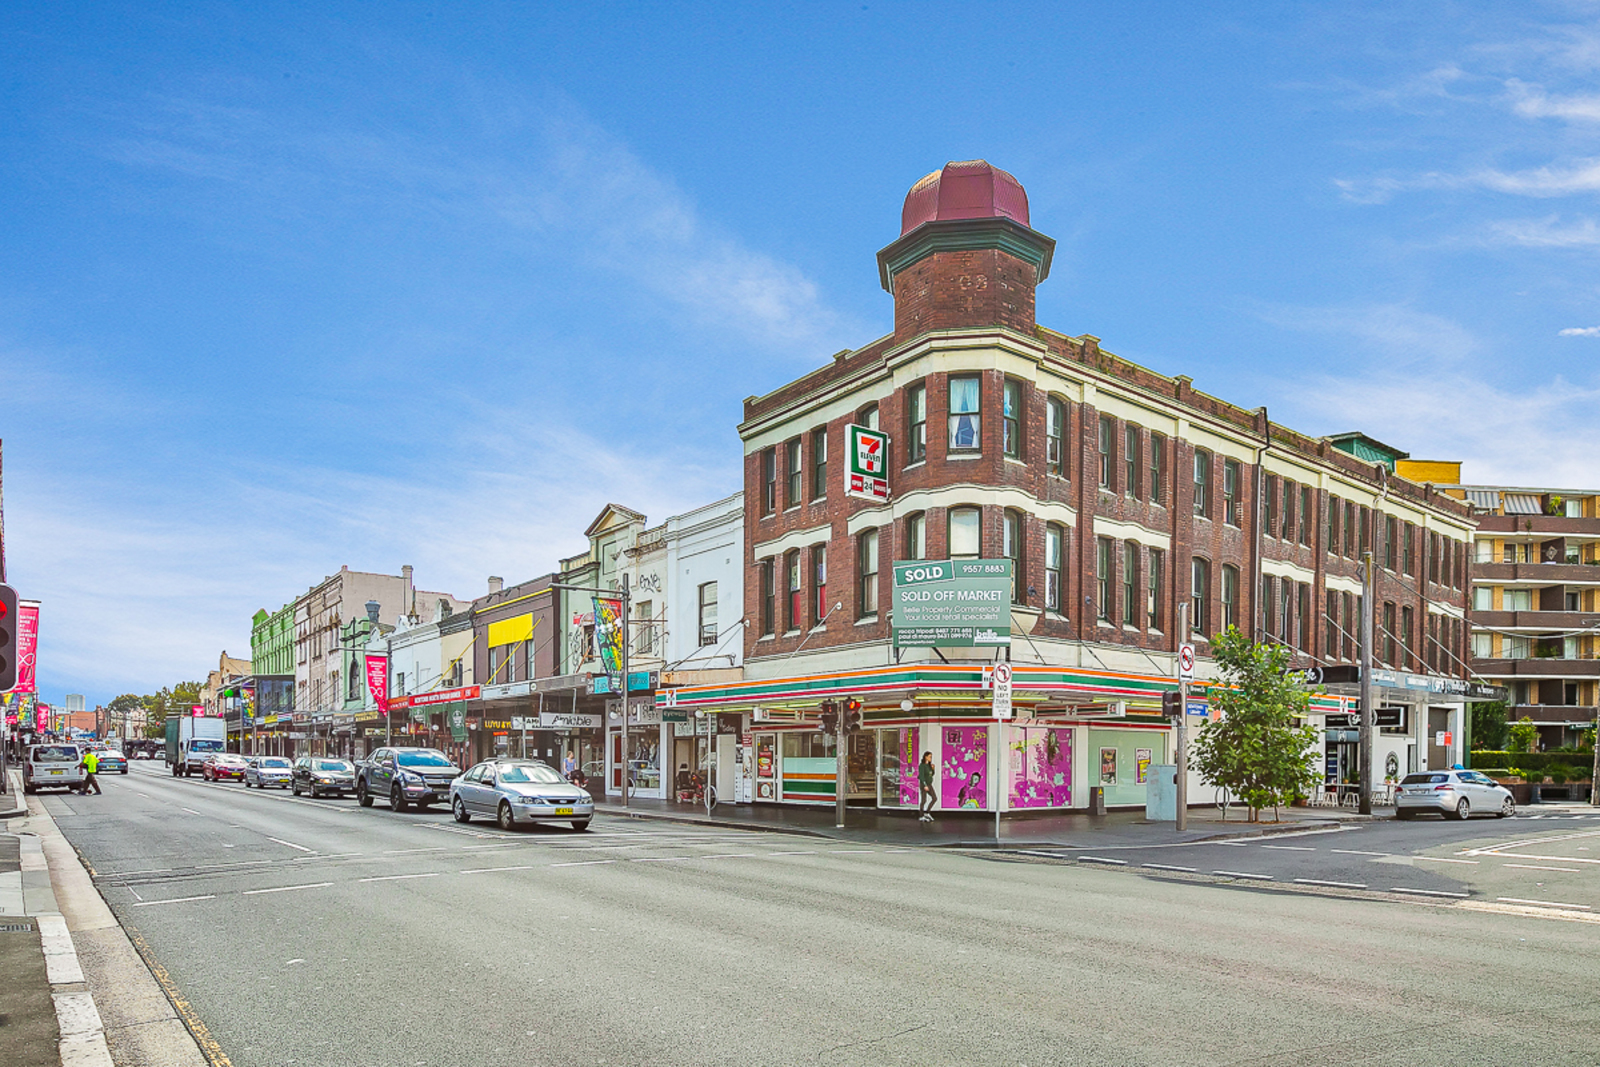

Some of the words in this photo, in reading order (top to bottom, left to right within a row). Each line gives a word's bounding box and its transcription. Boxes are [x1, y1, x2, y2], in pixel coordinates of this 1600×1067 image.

[861, 436, 880, 471] 7
[864, 481, 873, 490] 24
[962, 565, 983, 573] 9557
[904, 566, 944, 582] SOLD
[901, 591, 931, 602] SOLD
[933, 591, 955, 601] OFF
[957, 590, 1003, 601] MARKET
[921, 605, 953, 614] Property
[954, 605, 1001, 613] Commercial
[904, 613, 920, 621] Your
[942, 612, 961, 620] retail
[962, 612, 999, 621] specialists
